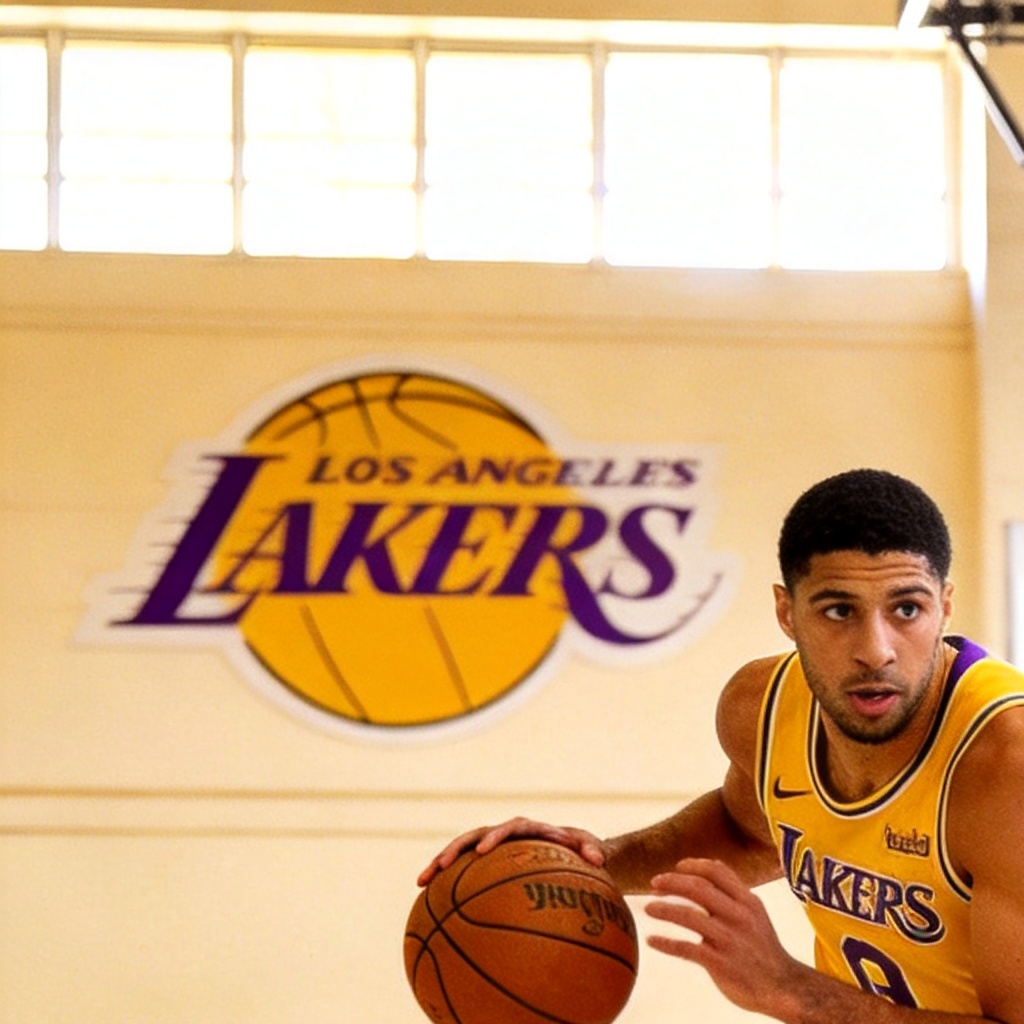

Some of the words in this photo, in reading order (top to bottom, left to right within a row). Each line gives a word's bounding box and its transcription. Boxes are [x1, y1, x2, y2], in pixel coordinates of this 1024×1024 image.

[307, 455, 416, 485] LOS
[424, 457, 700, 488] ANGELES
[108, 454, 724, 646] LAKERS
[776, 822, 946, 946] LAKERS
